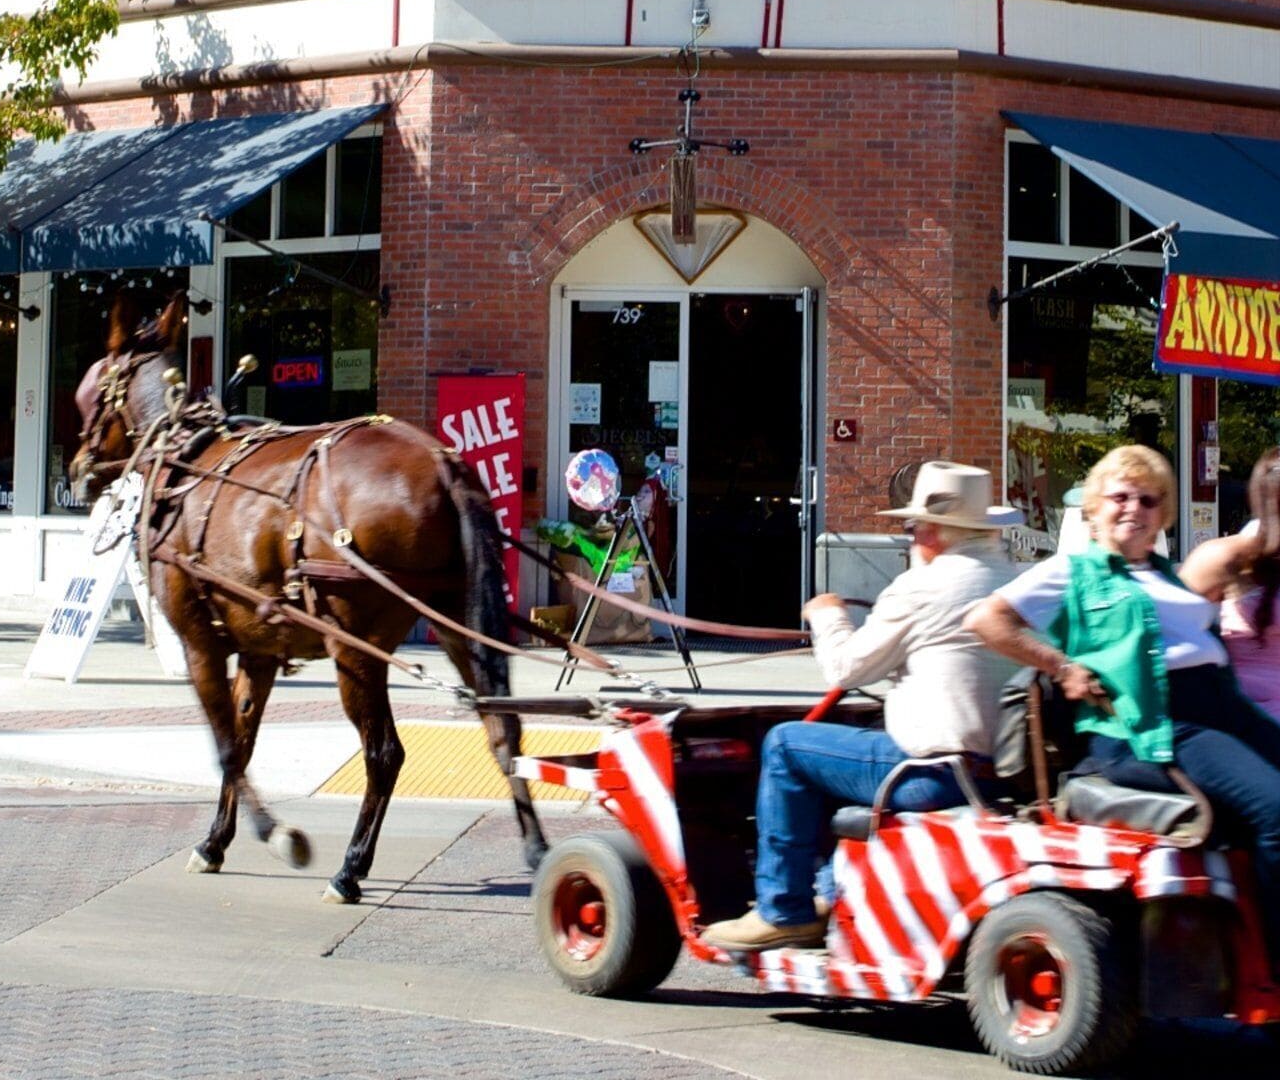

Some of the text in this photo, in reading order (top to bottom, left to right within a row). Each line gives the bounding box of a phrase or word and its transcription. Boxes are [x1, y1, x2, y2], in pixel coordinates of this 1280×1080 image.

[612, 307, 641, 324] 739
[273, 362, 319, 383] OPEN
[441, 397, 519, 455] SALE
